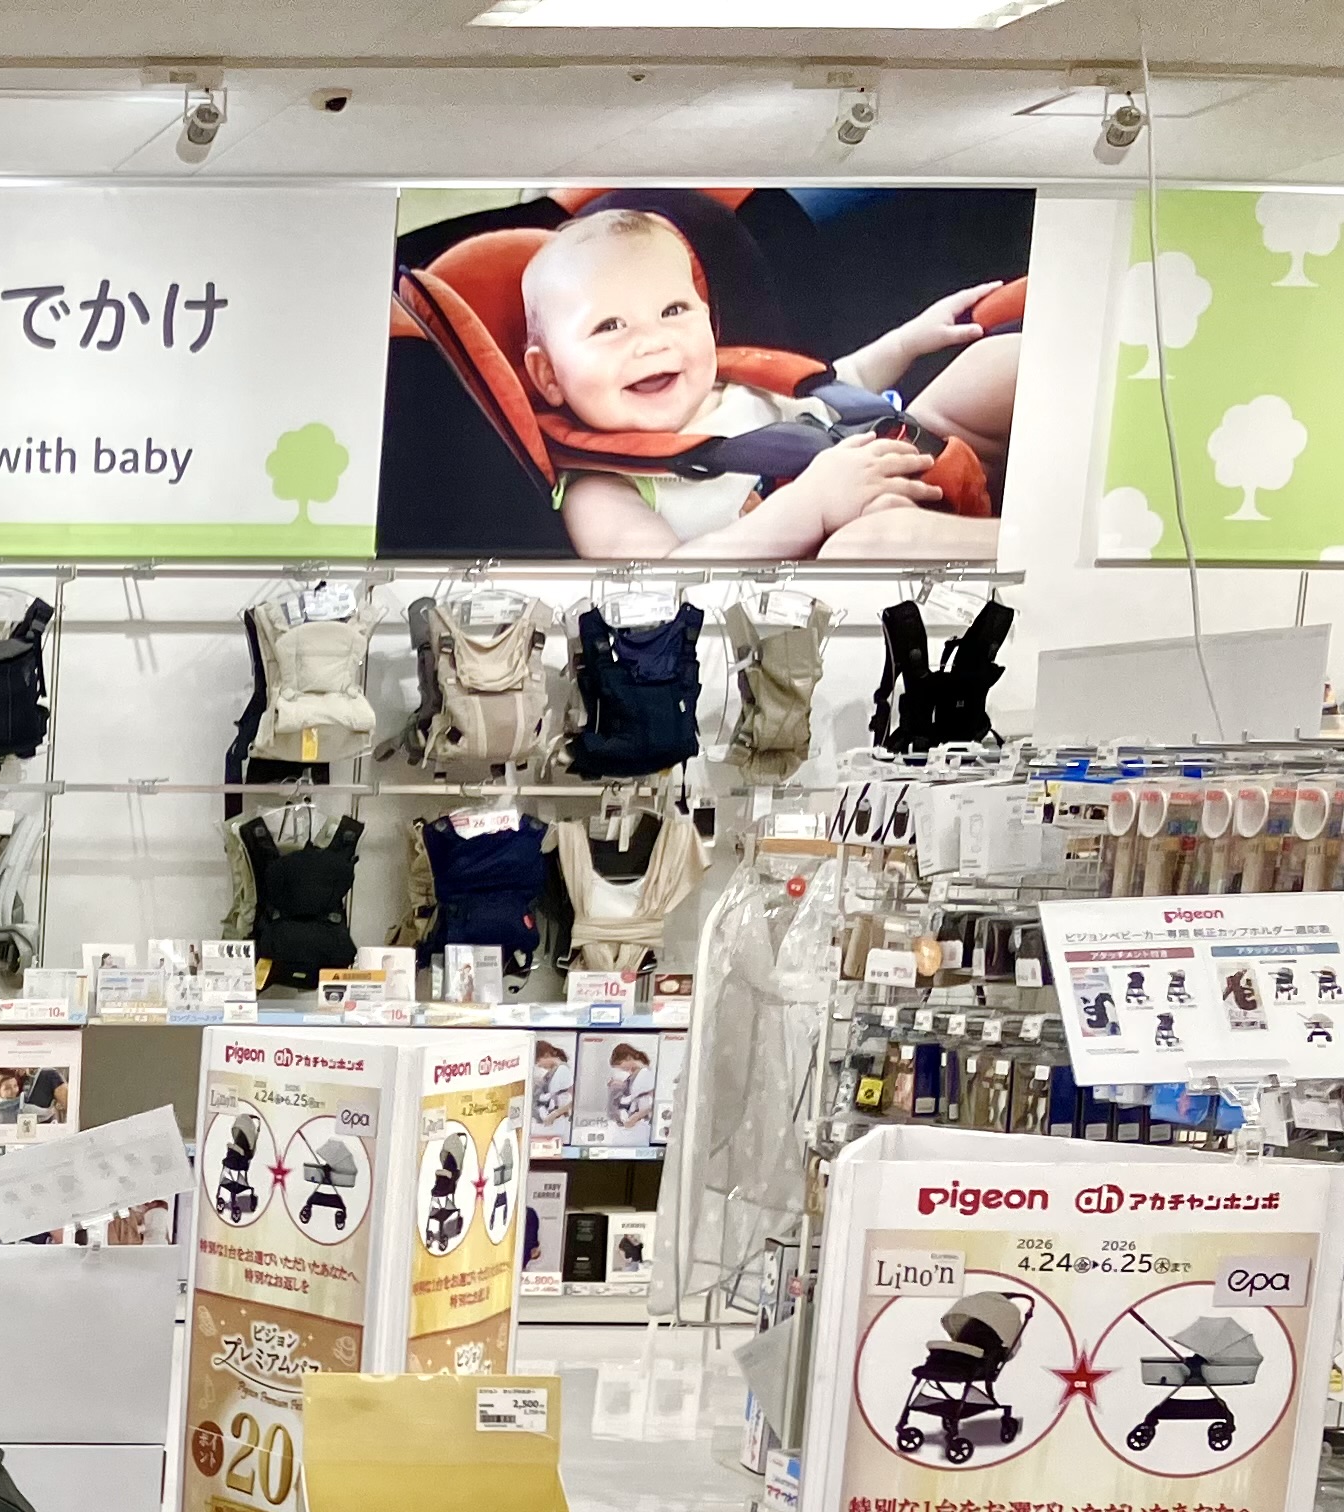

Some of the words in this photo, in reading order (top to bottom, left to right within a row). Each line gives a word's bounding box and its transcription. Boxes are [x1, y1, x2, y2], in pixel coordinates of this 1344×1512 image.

[93, 436, 193, 485] baby
[1163, 907, 1224, 923] pigeon
[225, 1041, 265, 1064] pigeon
[433, 1059, 472, 1085] pigeon
[340, 1108, 370, 1128] epa
[918, 1180, 1050, 1216] pigeon
[1129, 1192, 1281, 1212] アカチャンホンポ
[1016, 1238, 1053, 1250] 2026
[1100, 1240, 1137, 1252] 2026
[1227, 1268, 1291, 1296] epa
[225, 1412, 295, 1506] 20
